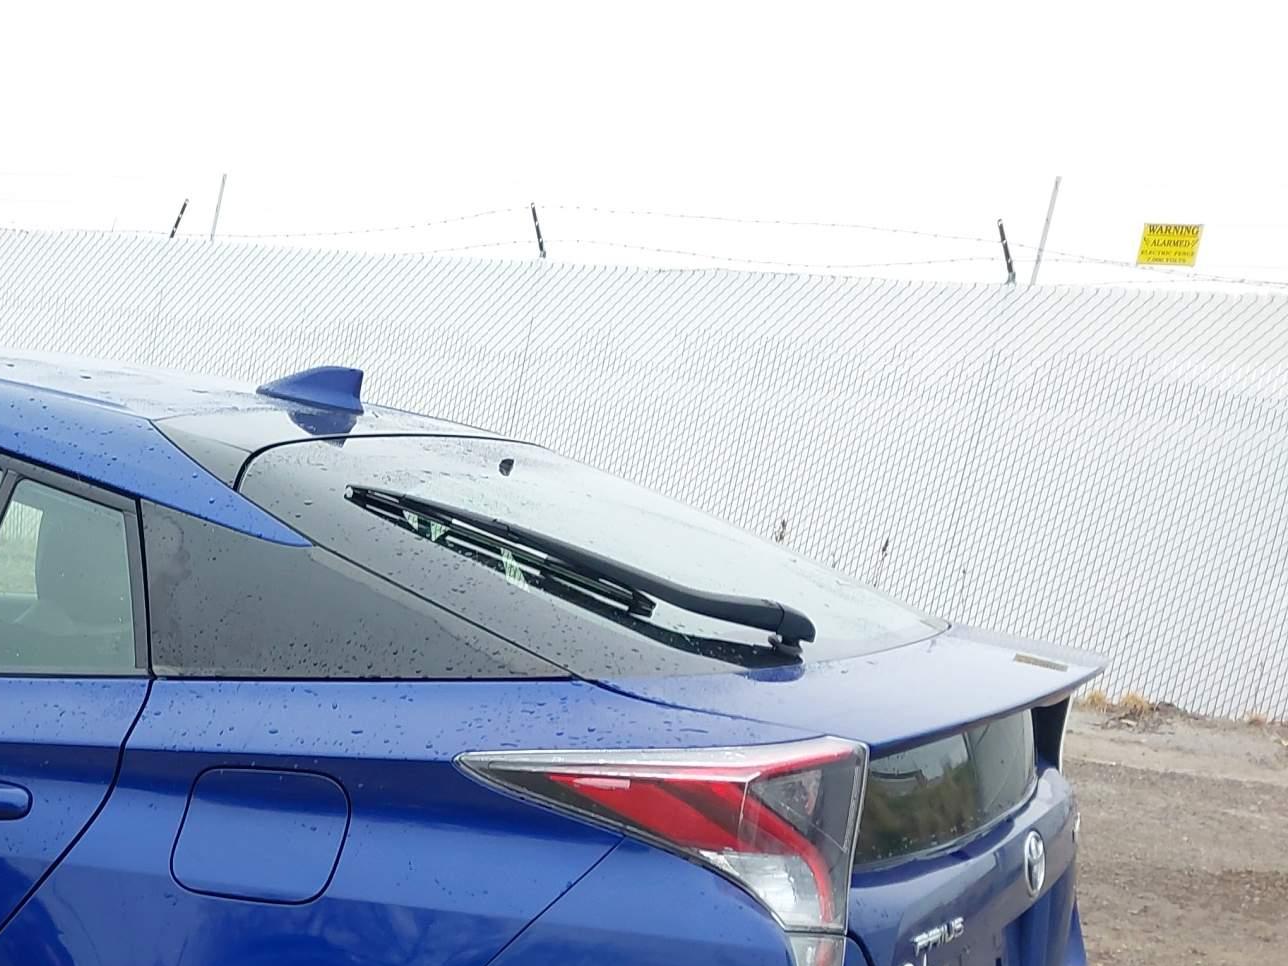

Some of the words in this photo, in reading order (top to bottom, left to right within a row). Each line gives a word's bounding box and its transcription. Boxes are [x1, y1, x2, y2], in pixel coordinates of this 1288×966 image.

[1148, 223, 1200, 236] WARNING
[1150, 238, 1190, 248] ALARMED
[912, 916, 965, 956] PRIUS
